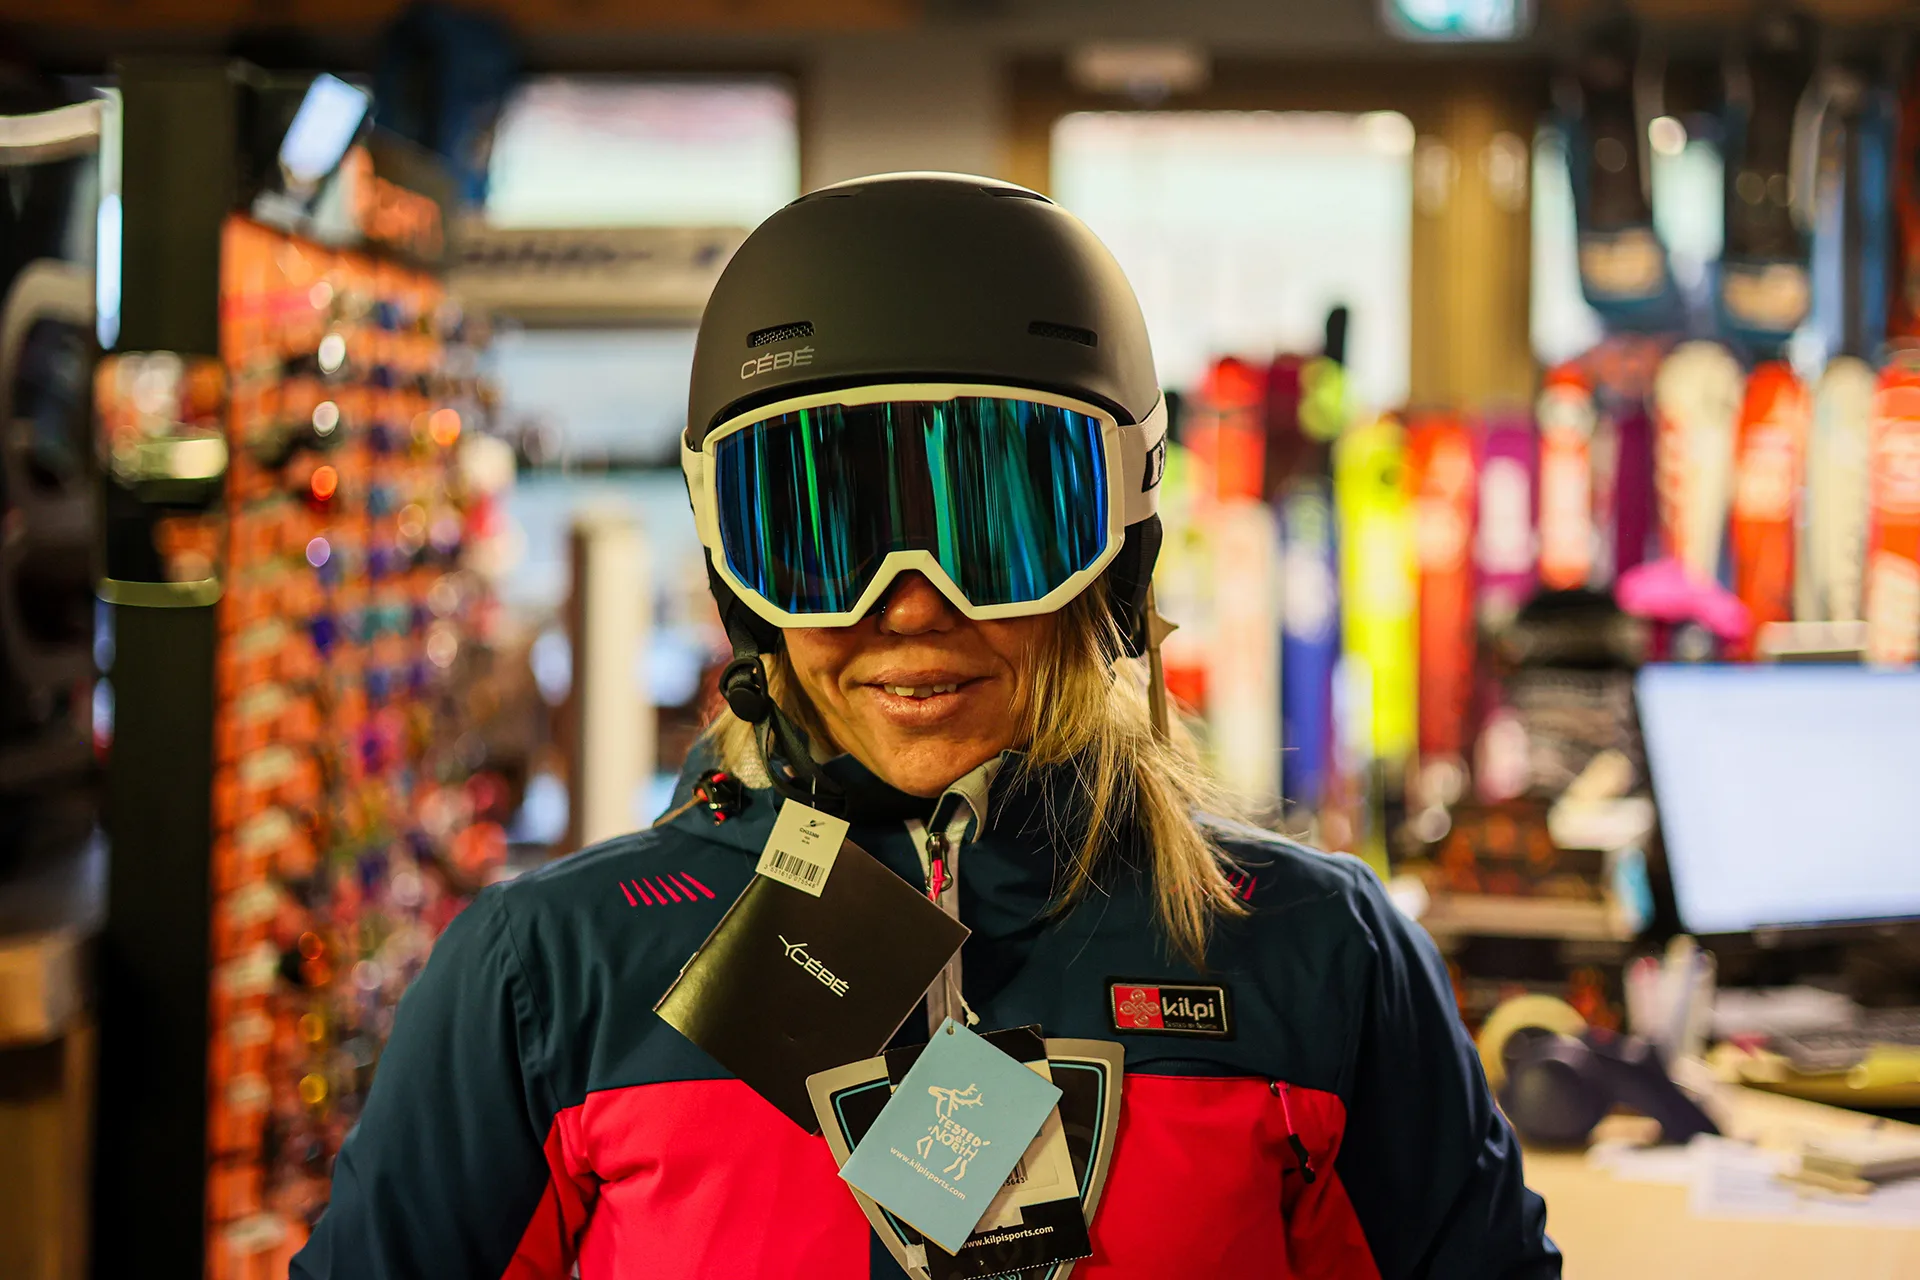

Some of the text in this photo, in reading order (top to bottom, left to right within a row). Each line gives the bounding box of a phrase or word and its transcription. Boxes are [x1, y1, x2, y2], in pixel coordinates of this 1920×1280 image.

[741, 346, 815, 380] CÉBÉ
[1162, 996, 1215, 1021] kilpi
[930, 1125, 979, 1162] NORTH
[938, 1113, 982, 1148] TESTED
[890, 1146, 966, 1200] www.kilpisports.com
